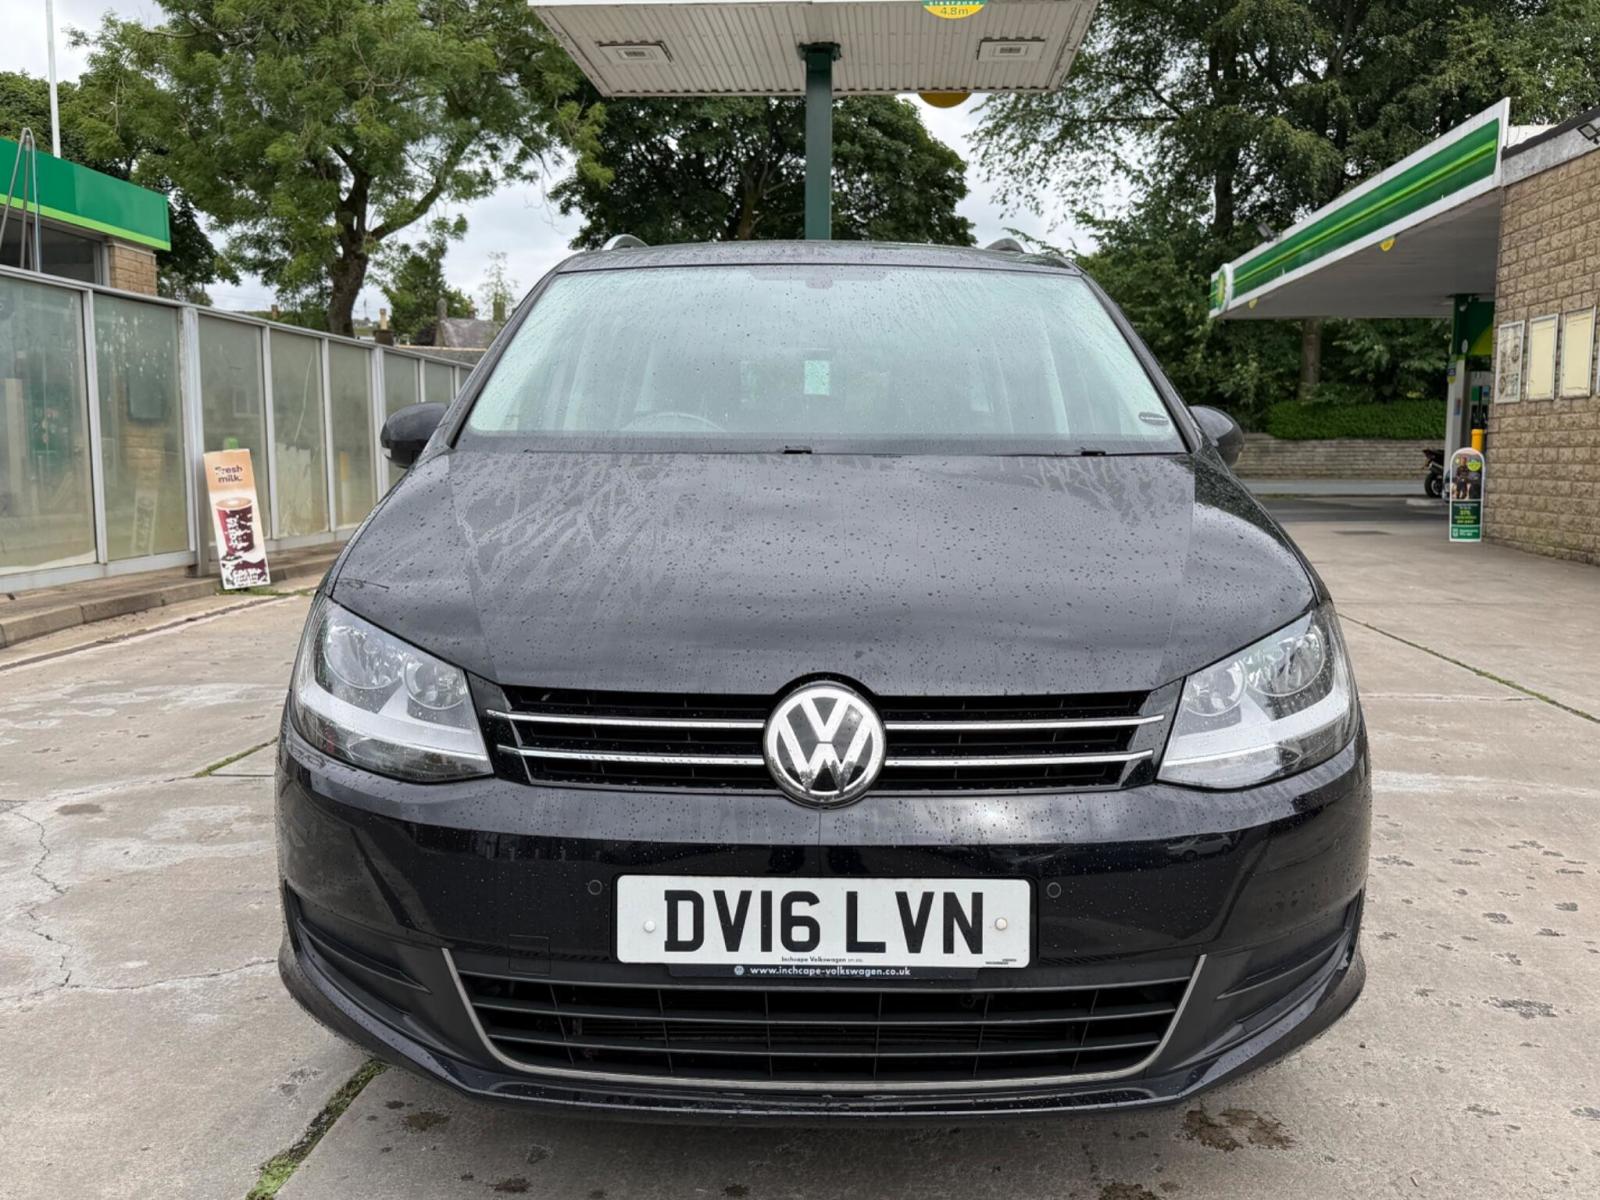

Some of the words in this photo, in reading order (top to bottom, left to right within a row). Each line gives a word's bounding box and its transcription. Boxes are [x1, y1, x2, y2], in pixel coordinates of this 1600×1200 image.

[664, 889, 821, 953] DV16
[845, 890, 984, 955] LVN
[809, 955, 847, 964] Volkswagen
[749, 965, 911, 977] www.inchcape-volkswagen.co.uk
